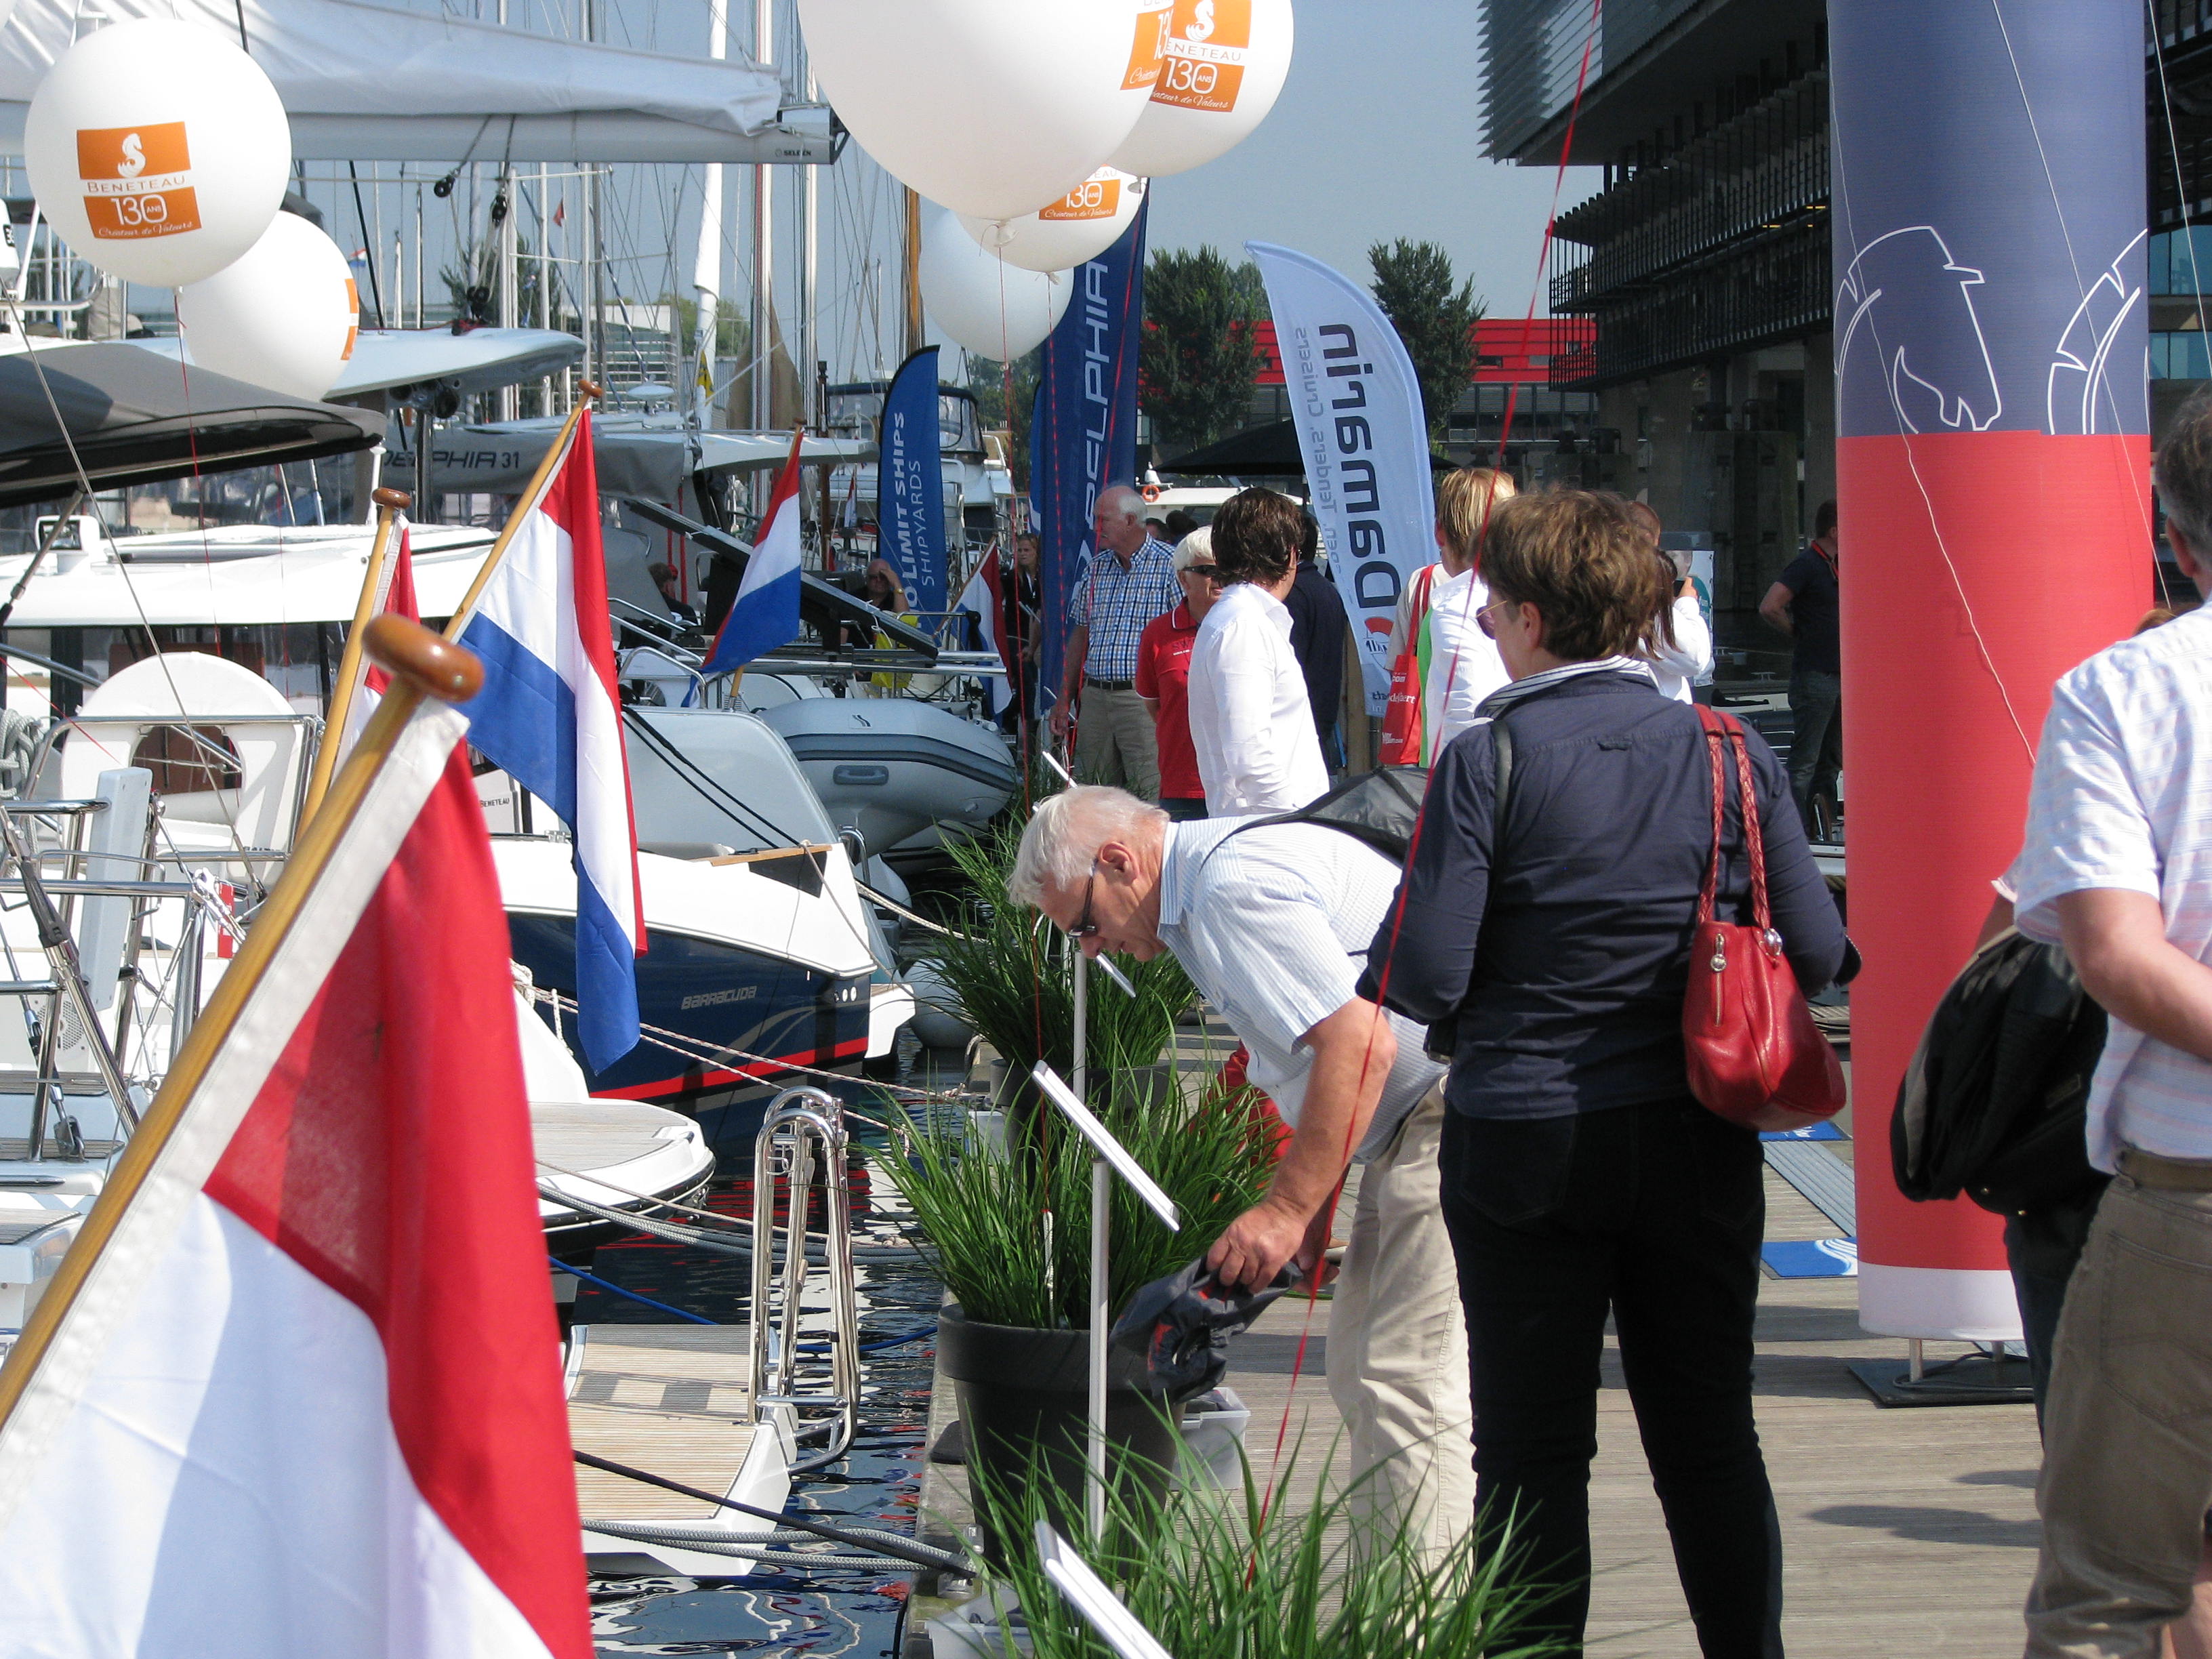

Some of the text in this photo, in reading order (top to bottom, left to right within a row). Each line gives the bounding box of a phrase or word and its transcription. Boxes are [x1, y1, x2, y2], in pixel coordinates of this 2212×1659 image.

[1166, 42, 1242, 61] ENETEAU
[1165, 57, 1218, 94] 130
[1197, 75, 1212, 83] ANS
[1181, 96, 1193, 104] de
[1193, 95, 1229, 108] Valeurs
[87, 175, 185, 192] BENETEAU
[110, 194, 168, 225] 130 ANS
[1084, 260, 1109, 530] DELPHIA
[501, 452, 520, 468] 31
[893, 411, 906, 496] SHIPS
[909, 459, 935, 586] SHIPYARDS
[896, 502, 918, 579] LIMIT
[480, 798, 510, 808] BENETEAU
[681, 985, 757, 1010] BARRACUDA
